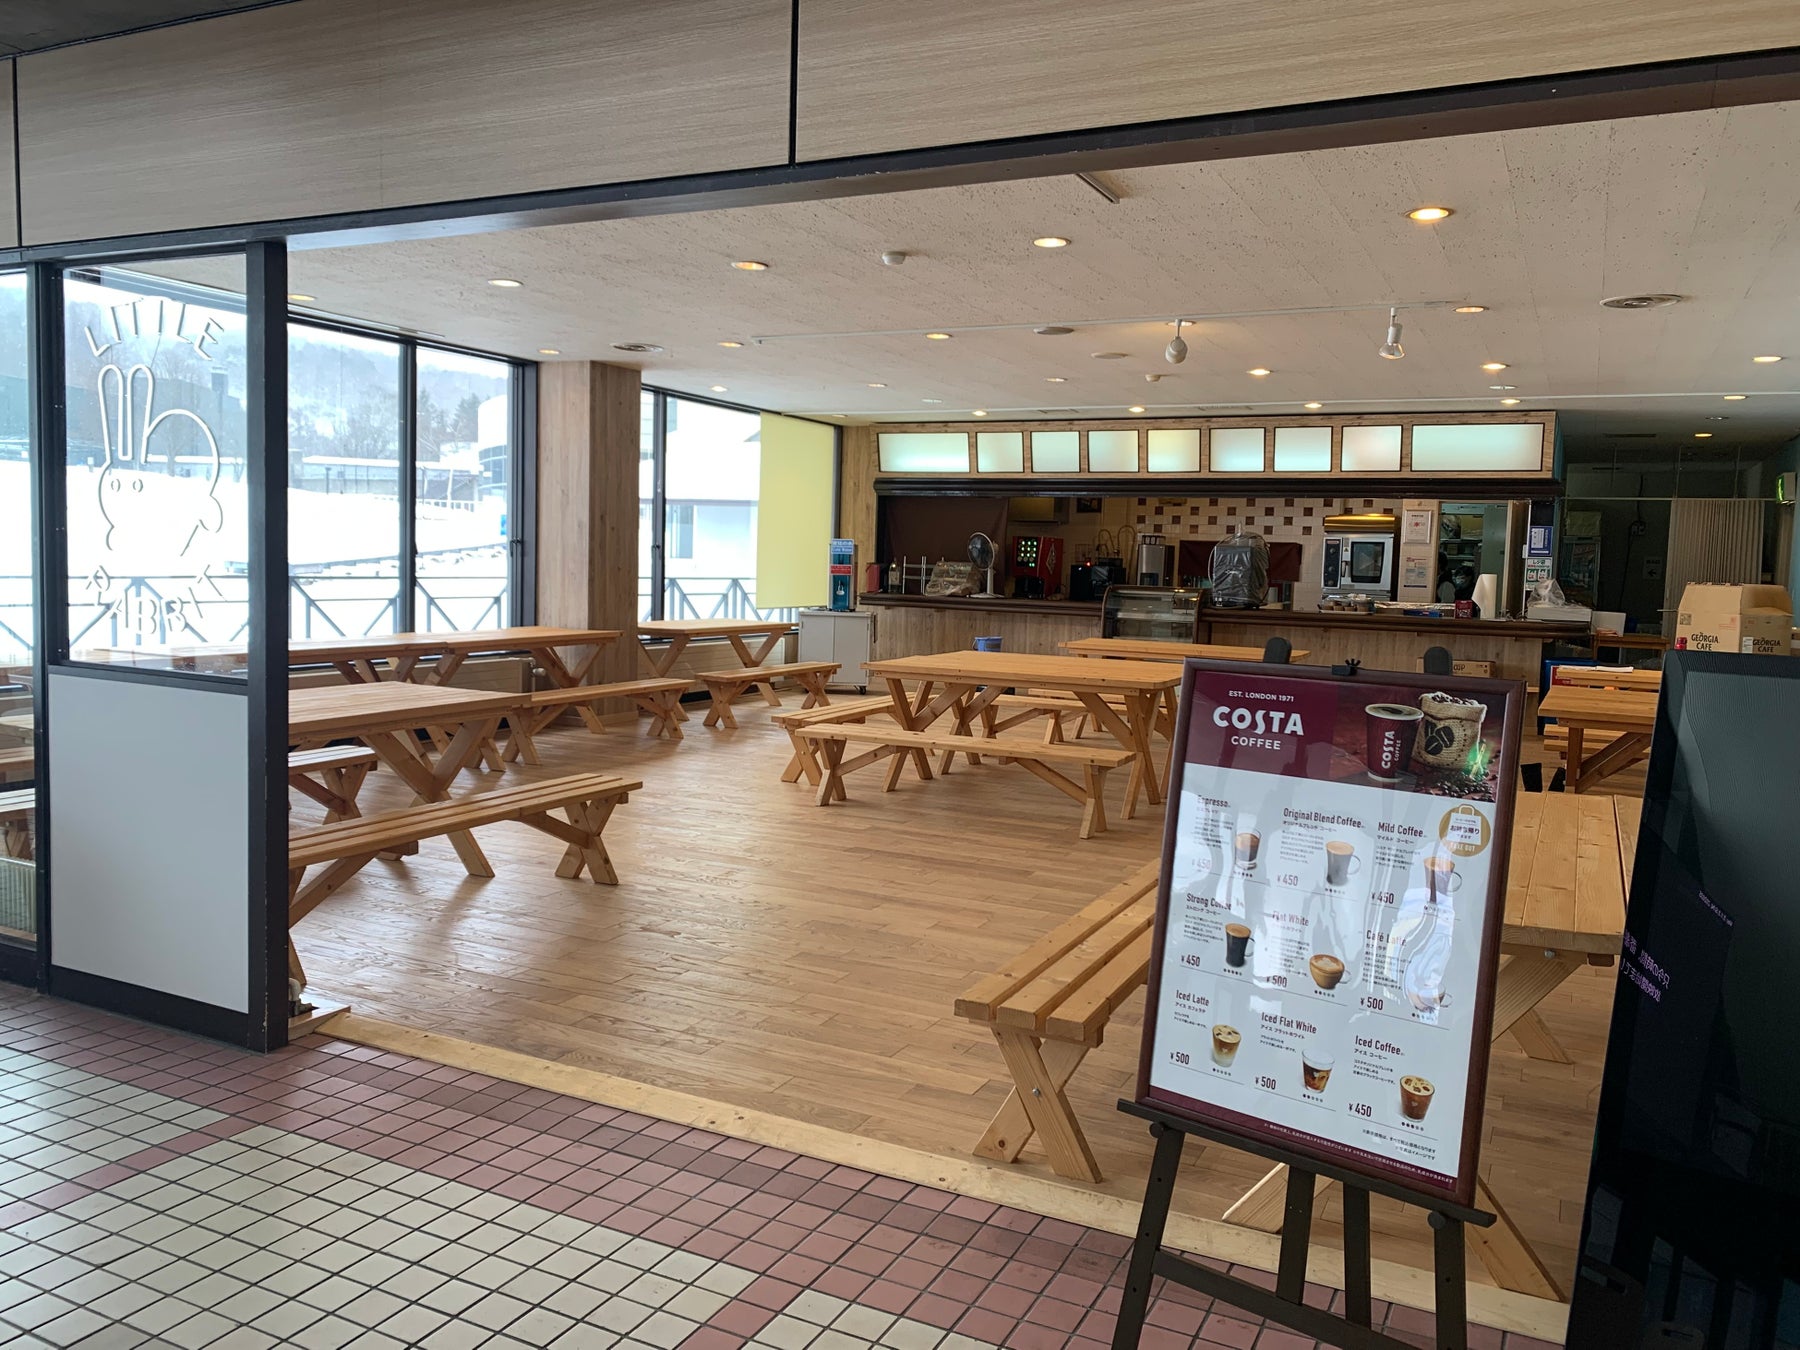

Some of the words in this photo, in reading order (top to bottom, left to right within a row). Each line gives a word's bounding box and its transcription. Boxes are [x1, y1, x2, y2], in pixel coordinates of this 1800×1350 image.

[84, 295, 224, 361] LITTLE
[85, 564, 226, 635] RABBIT
[1696, 642, 1712, 651] CAFE
[1228, 690, 1244, 698] EST.
[1245, 692, 1277, 701] LONDON
[1278, 694, 1294, 702] 1971
[1212, 705, 1305, 736] COSTA
[1230, 735, 1282, 750] COFFEE
[1380, 730, 1395, 769] COSTA
[1394, 739, 1402, 762] COFFEE
[1283, 807, 1313, 822] Original
[1314, 812, 1336, 824] Blend
[1336, 815, 1362, 829] Coffee
[1378, 822, 1395, 833] Mild
[1397, 824, 1424, 838] Coffee
[1186, 892, 1208, 908] Strong
[1288, 914, 1310, 927] White
[1366, 929, 1384, 942] Café
[1175, 989, 1191, 1002] Iced
[1192, 992, 1210, 1007] Latte
[1261, 1012, 1278, 1024] Iced
[1279, 1015, 1294, 1029] Flat
[1296, 1018, 1317, 1034] White
[1354, 1048, 1368, 1056] アイス
[1369, 1052, 1388, 1060] コーヒー
[1355, 1035, 1372, 1048] Iced
[1374, 1040, 1401, 1056] Coffee
